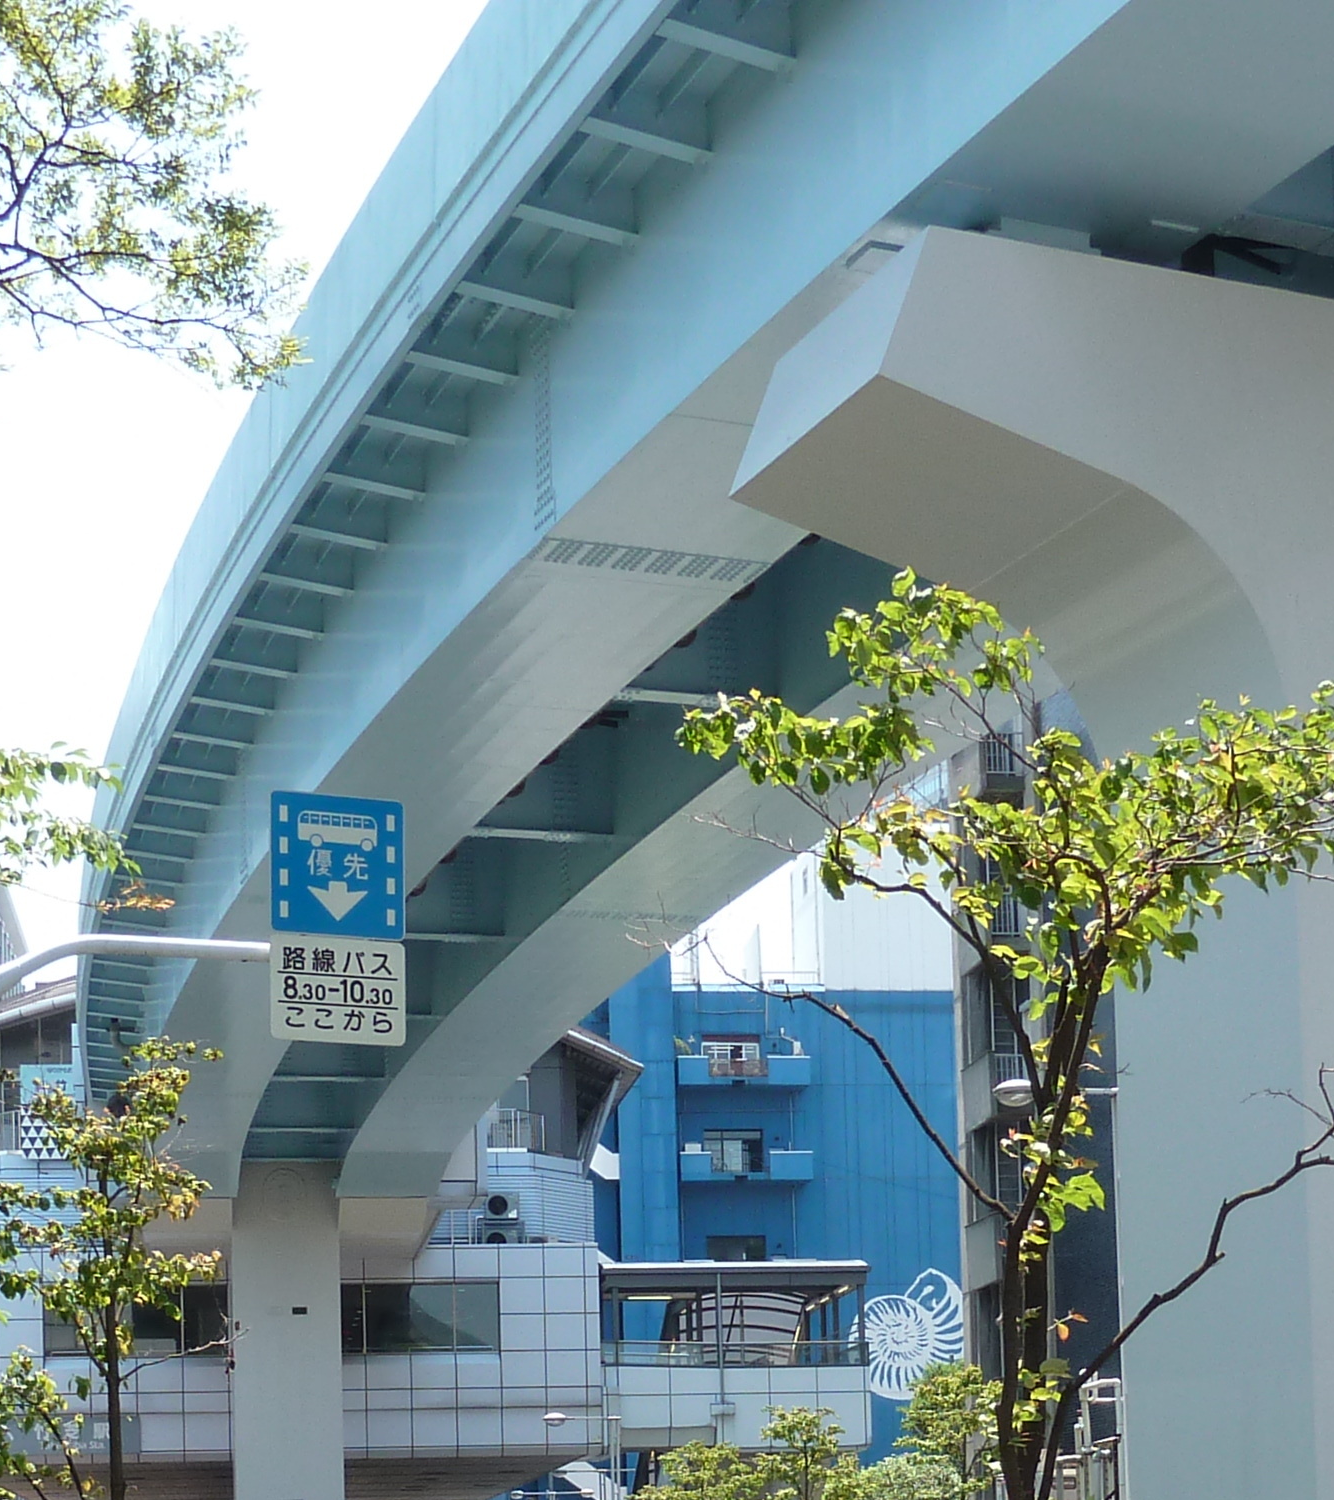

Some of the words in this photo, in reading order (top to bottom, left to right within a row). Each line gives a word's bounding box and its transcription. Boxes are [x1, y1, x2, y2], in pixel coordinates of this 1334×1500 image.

[307, 849, 369, 881] 優先
[282, 946, 393, 976] 路線バス
[283, 975, 393, 1006] 8.30-10.30
[285, 1006, 393, 1034] ここから
